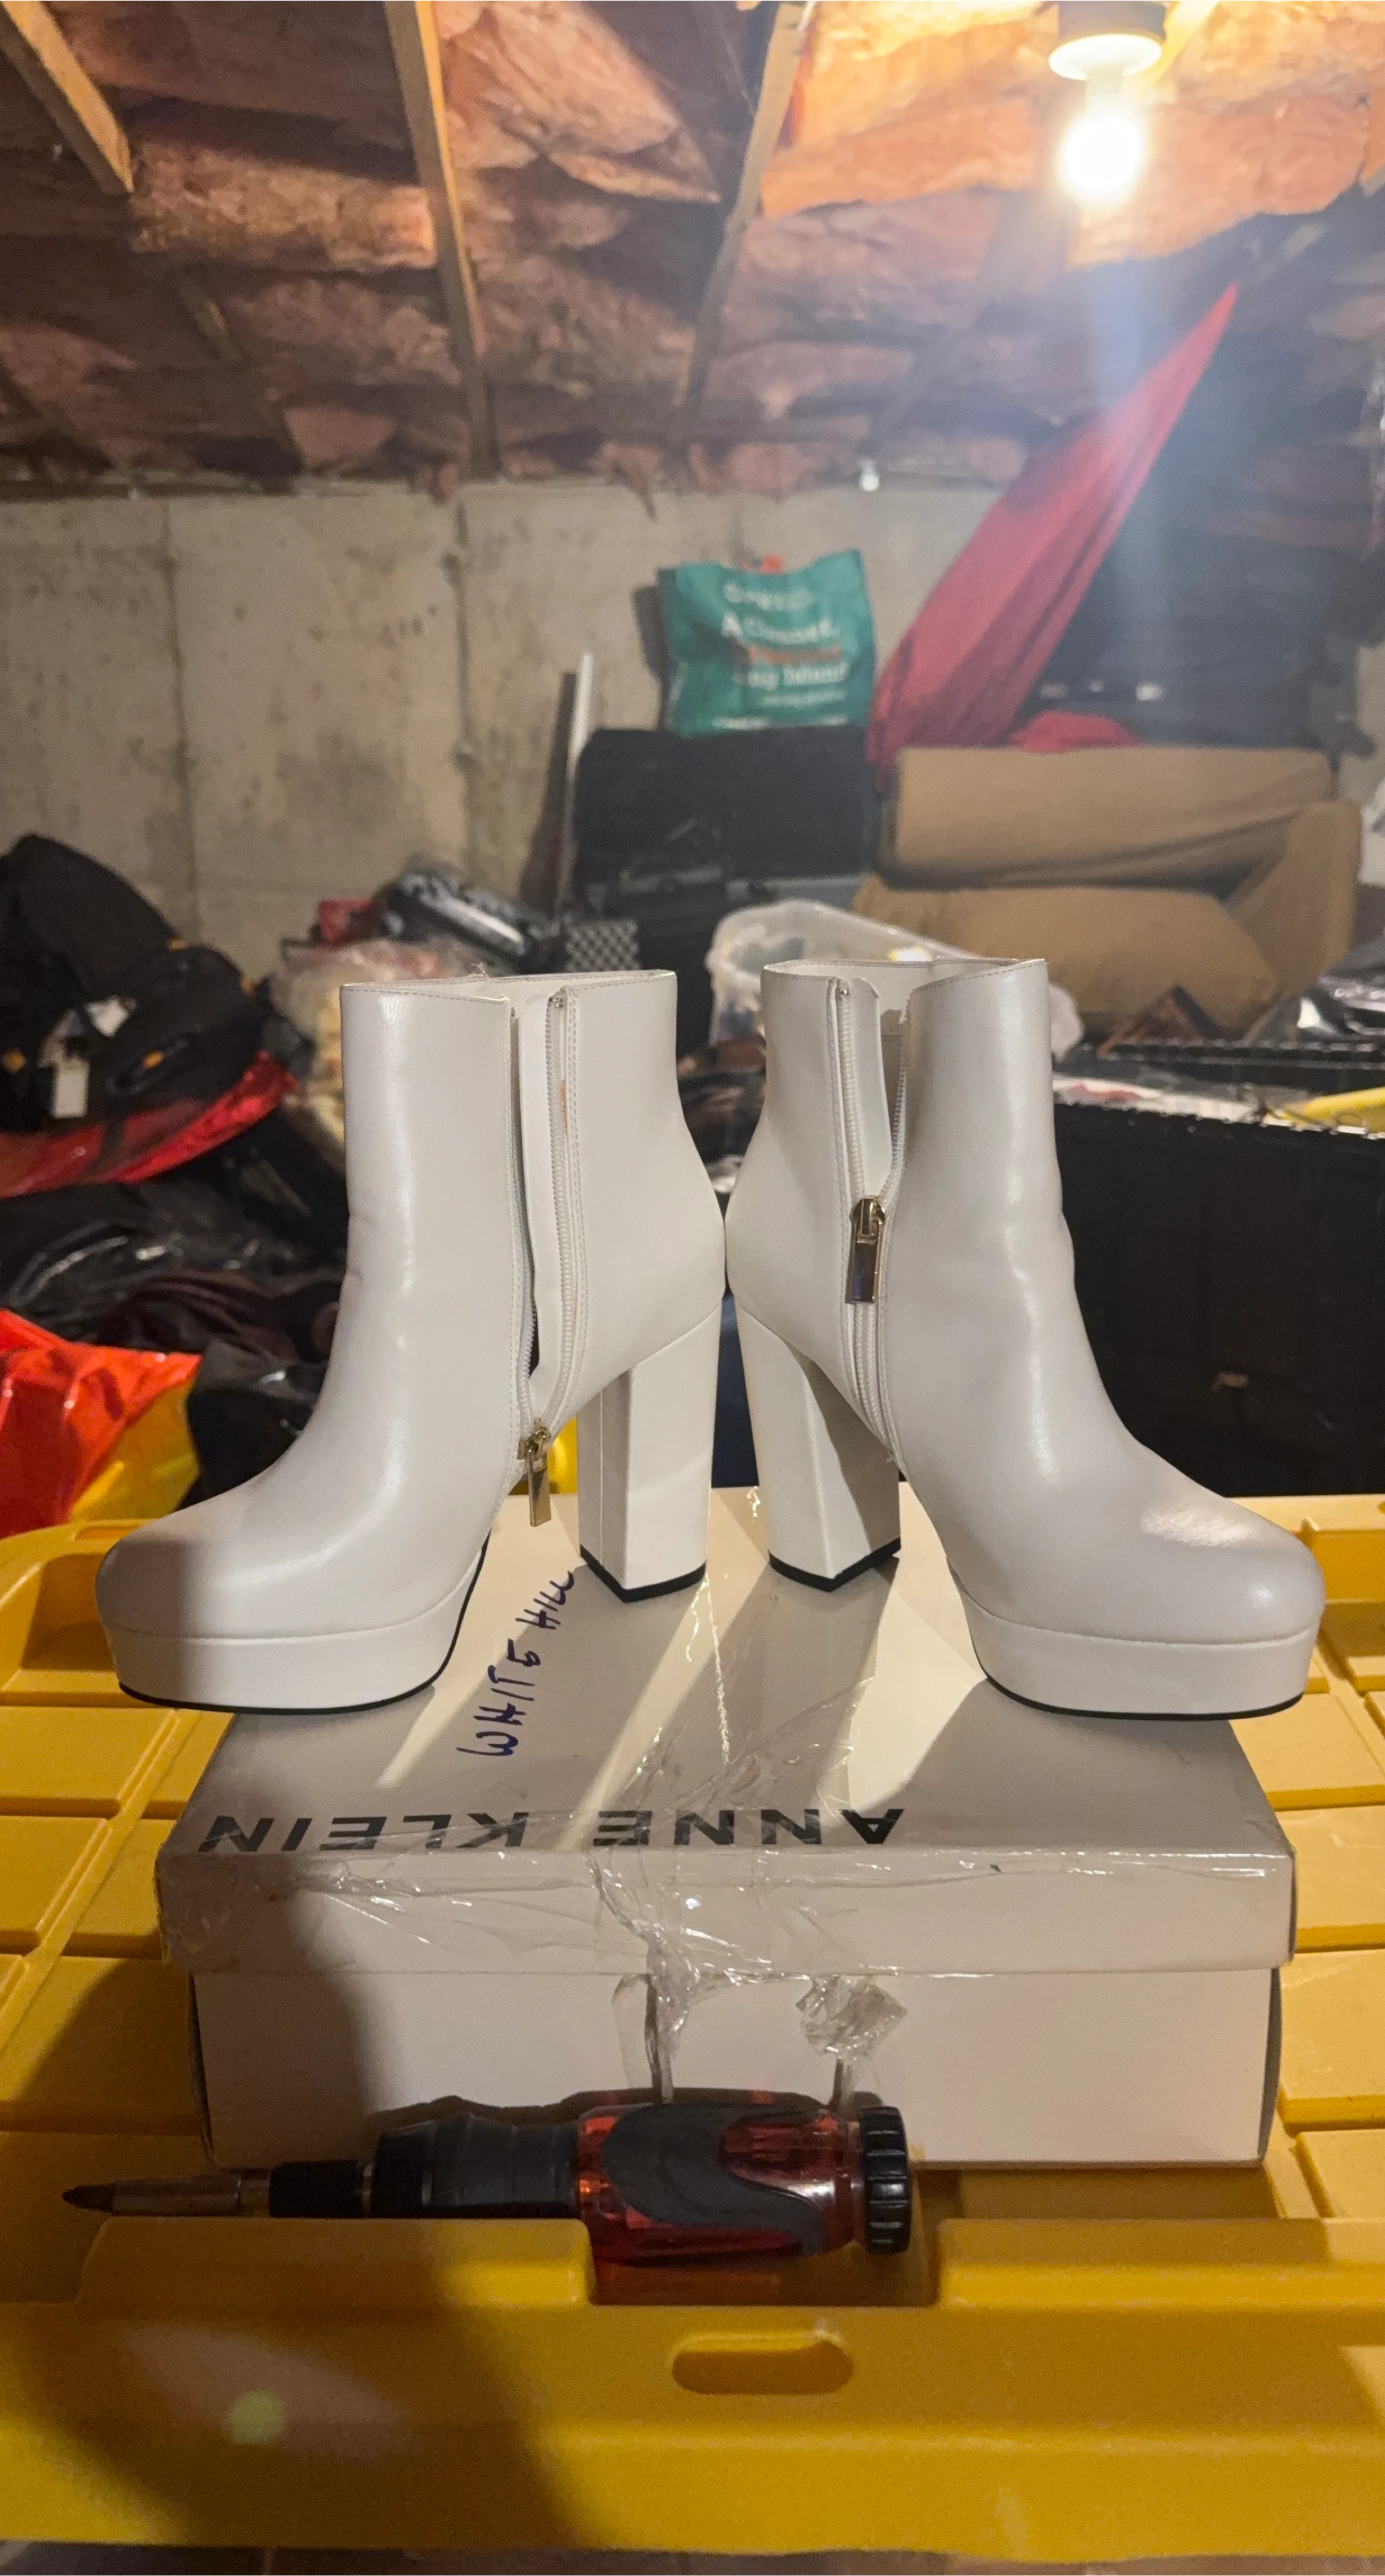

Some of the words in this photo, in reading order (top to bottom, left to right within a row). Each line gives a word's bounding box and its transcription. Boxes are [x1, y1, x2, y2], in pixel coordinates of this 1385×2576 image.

[456, 1638, 541, 1756] WHITE
[515, 1570, 574, 1630] HILL
[197, 1812, 530, 1853] KLEIN
[593, 1809, 905, 1847] ANNE
